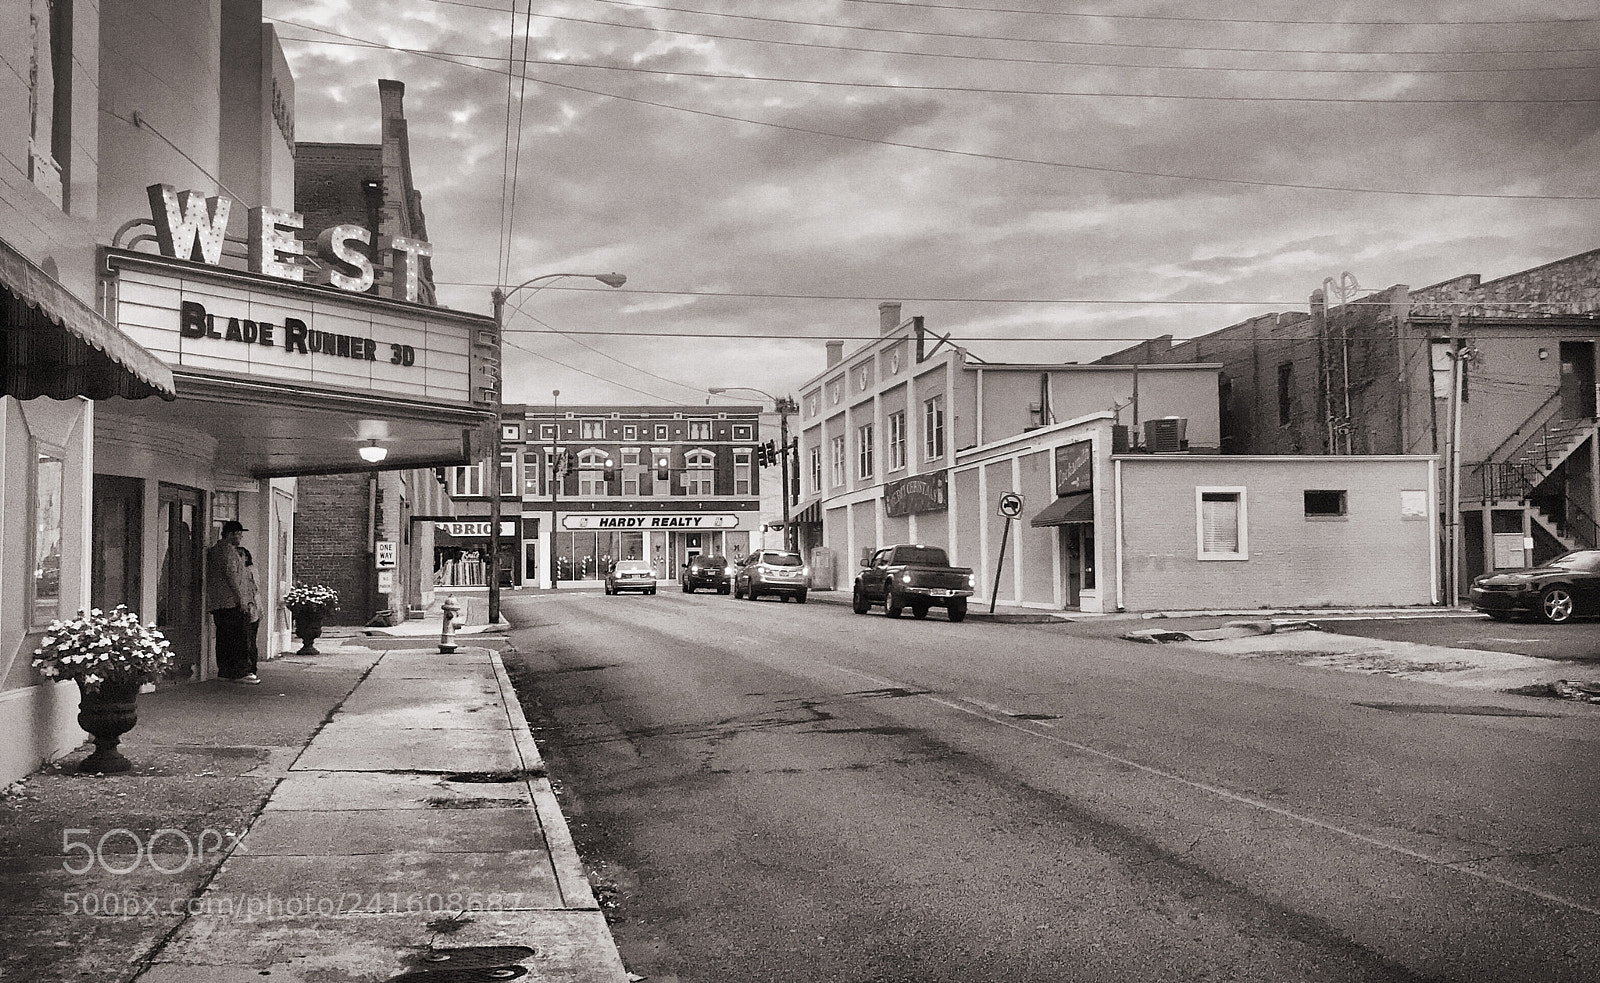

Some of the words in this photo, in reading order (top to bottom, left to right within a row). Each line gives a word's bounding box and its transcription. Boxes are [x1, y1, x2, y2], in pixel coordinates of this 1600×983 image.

[147, 183, 432, 301] WEST
[181, 300, 274, 347] BLADE
[285, 317, 376, 362] RUNNER
[390, 343, 416, 367] 3D
[599, 517, 646, 527] HARDY
[651, 517, 703, 527] REALTY
